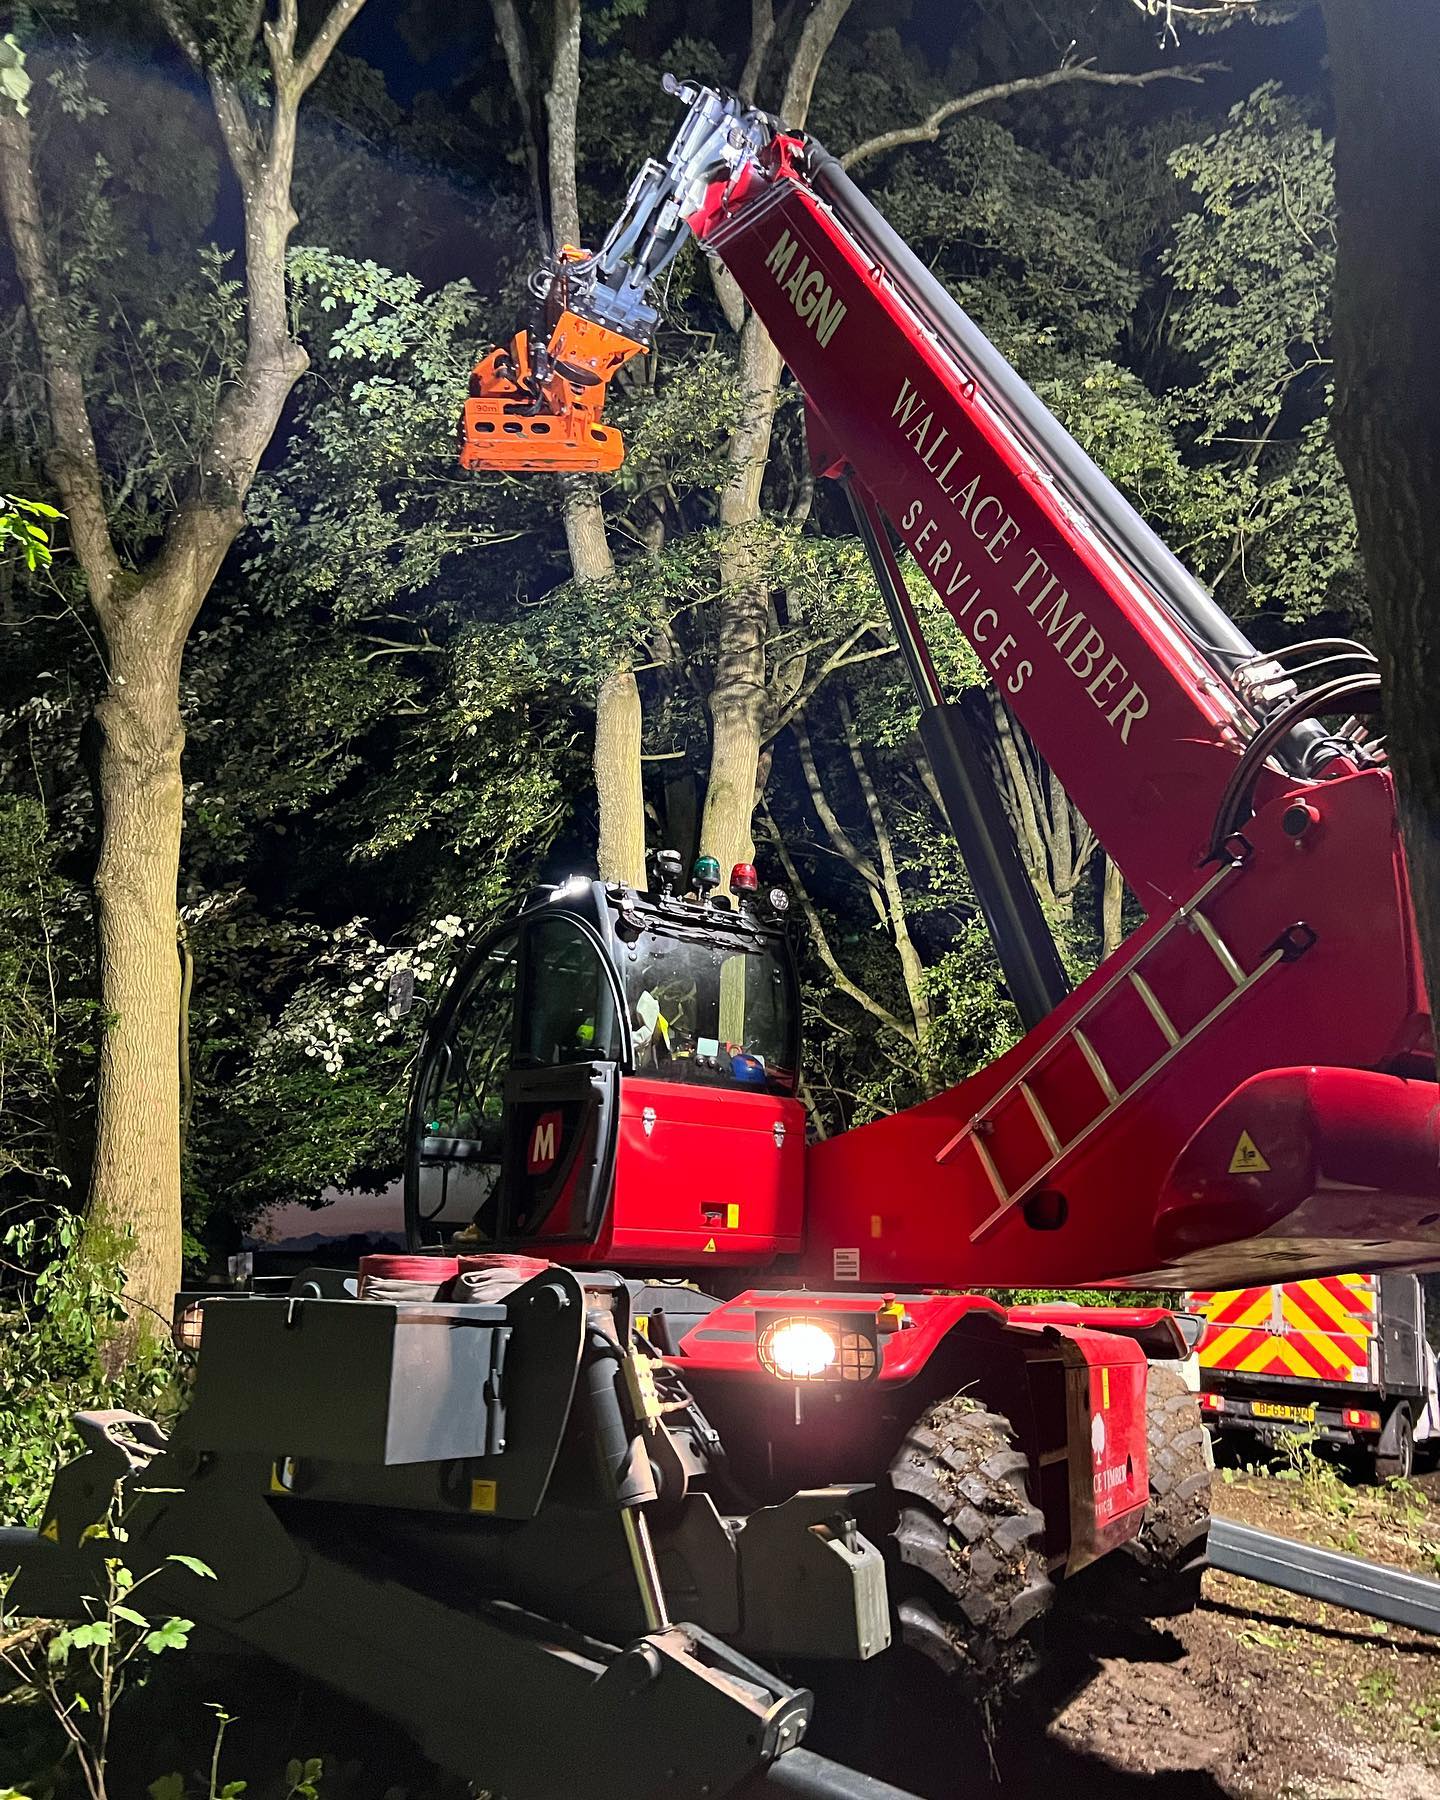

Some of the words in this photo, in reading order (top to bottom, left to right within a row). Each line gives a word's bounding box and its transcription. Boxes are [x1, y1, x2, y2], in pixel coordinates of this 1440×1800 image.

[764, 228, 848, 349] MAGNI
[891, 376, 1021, 564] WALLACE
[1012, 547, 1149, 745] TIMBER
[901, 499, 1034, 694] SERVICES
[532, 1122, 555, 1162] M
